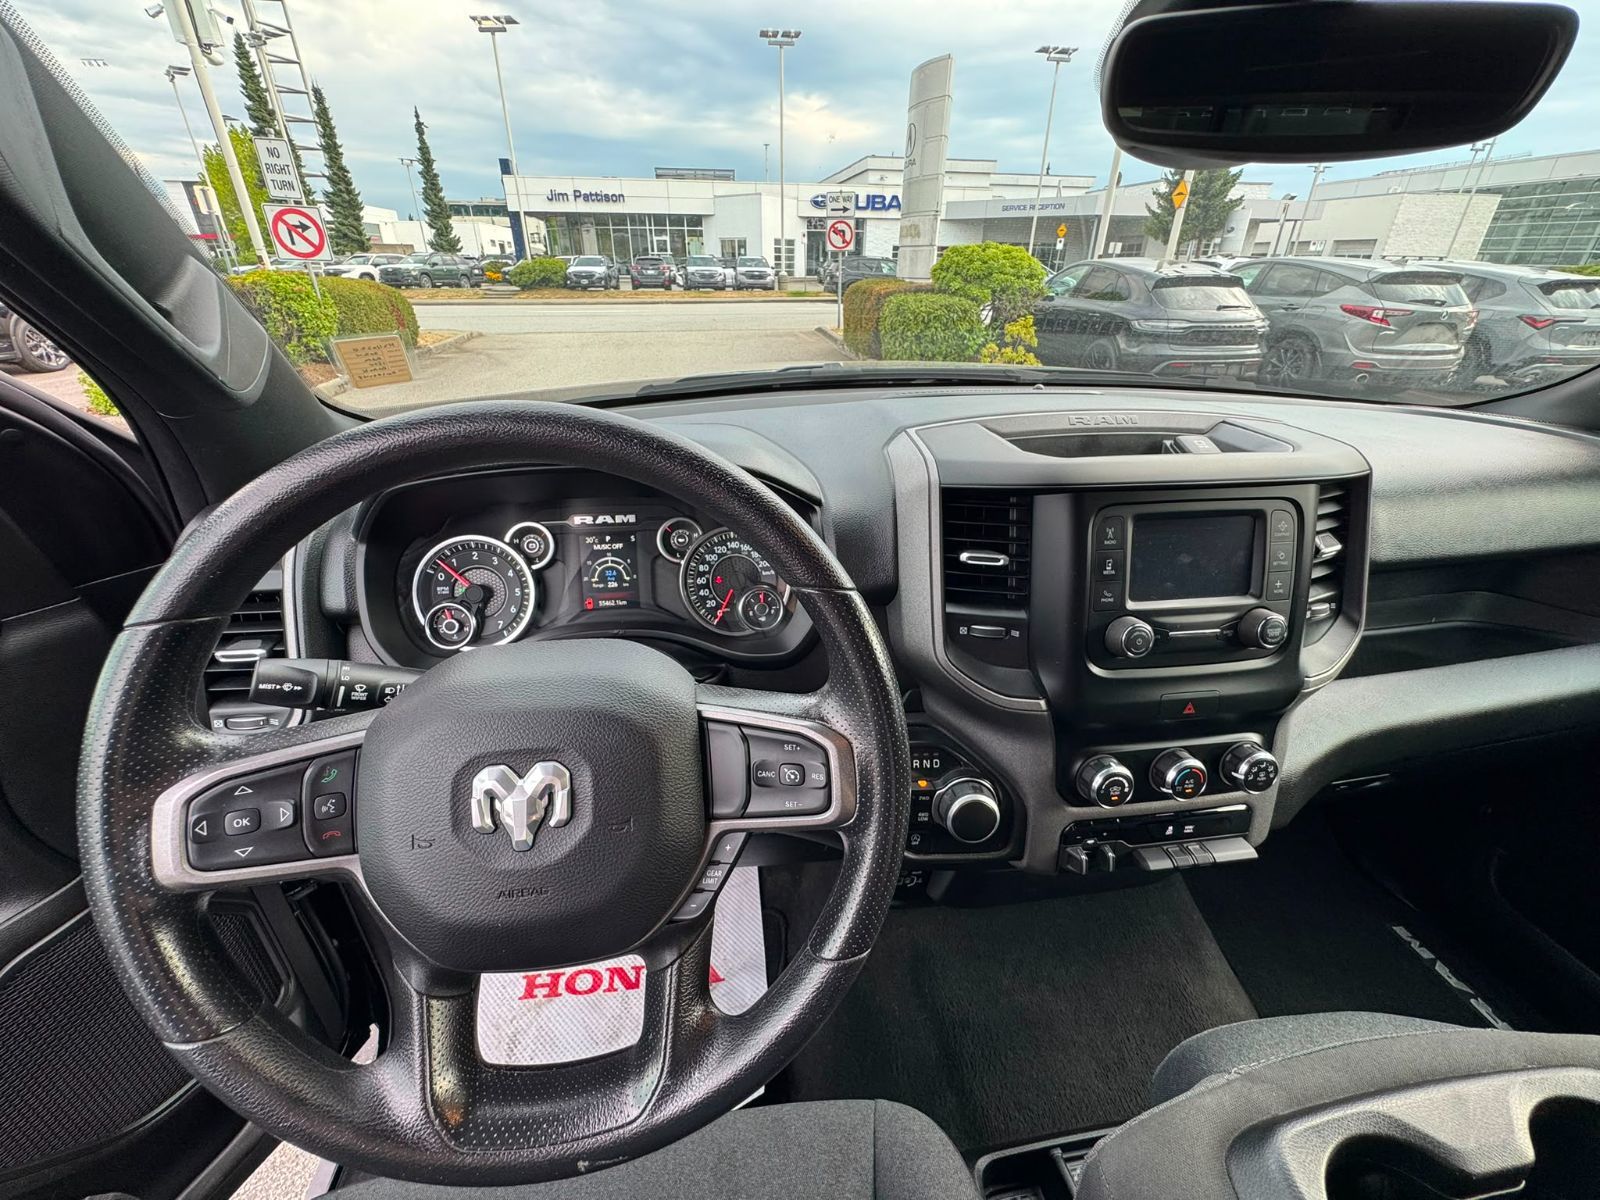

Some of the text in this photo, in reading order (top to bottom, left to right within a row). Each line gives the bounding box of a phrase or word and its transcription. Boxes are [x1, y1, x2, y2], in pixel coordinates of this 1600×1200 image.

[266, 146, 280, 159] NO
[264, 163, 291, 175] RIGHT
[270, 179, 295, 191] TURN
[546, 189, 625, 203] Jim Pattison
[828, 195, 853, 203] ONE WAY
[855, 193, 901, 212] UBA
[1001, 204, 1028, 212] SERVICE
[1068, 414, 1138, 426] RAM
[573, 514, 636, 525] RAM
[726, 541, 740, 549] 140
[713, 546, 727, 554] 120
[472, 552, 479, 560] 2
[492, 556, 498, 565] 3
[698, 564, 709, 572] 80
[438, 572, 445, 581] 0
[508, 569, 514, 577] 4
[515, 588, 520, 596] 5
[510, 604, 516, 613] 6
[497, 621, 504, 629] 7
[912, 759, 940, 768] R N D
[757, 770, 776, 778] CANC
[811, 773, 824, 781] RES
[233, 817, 251, 828] OK
[498, 888, 550, 899] AIRBAG
[518, 965, 645, 1001] HON
